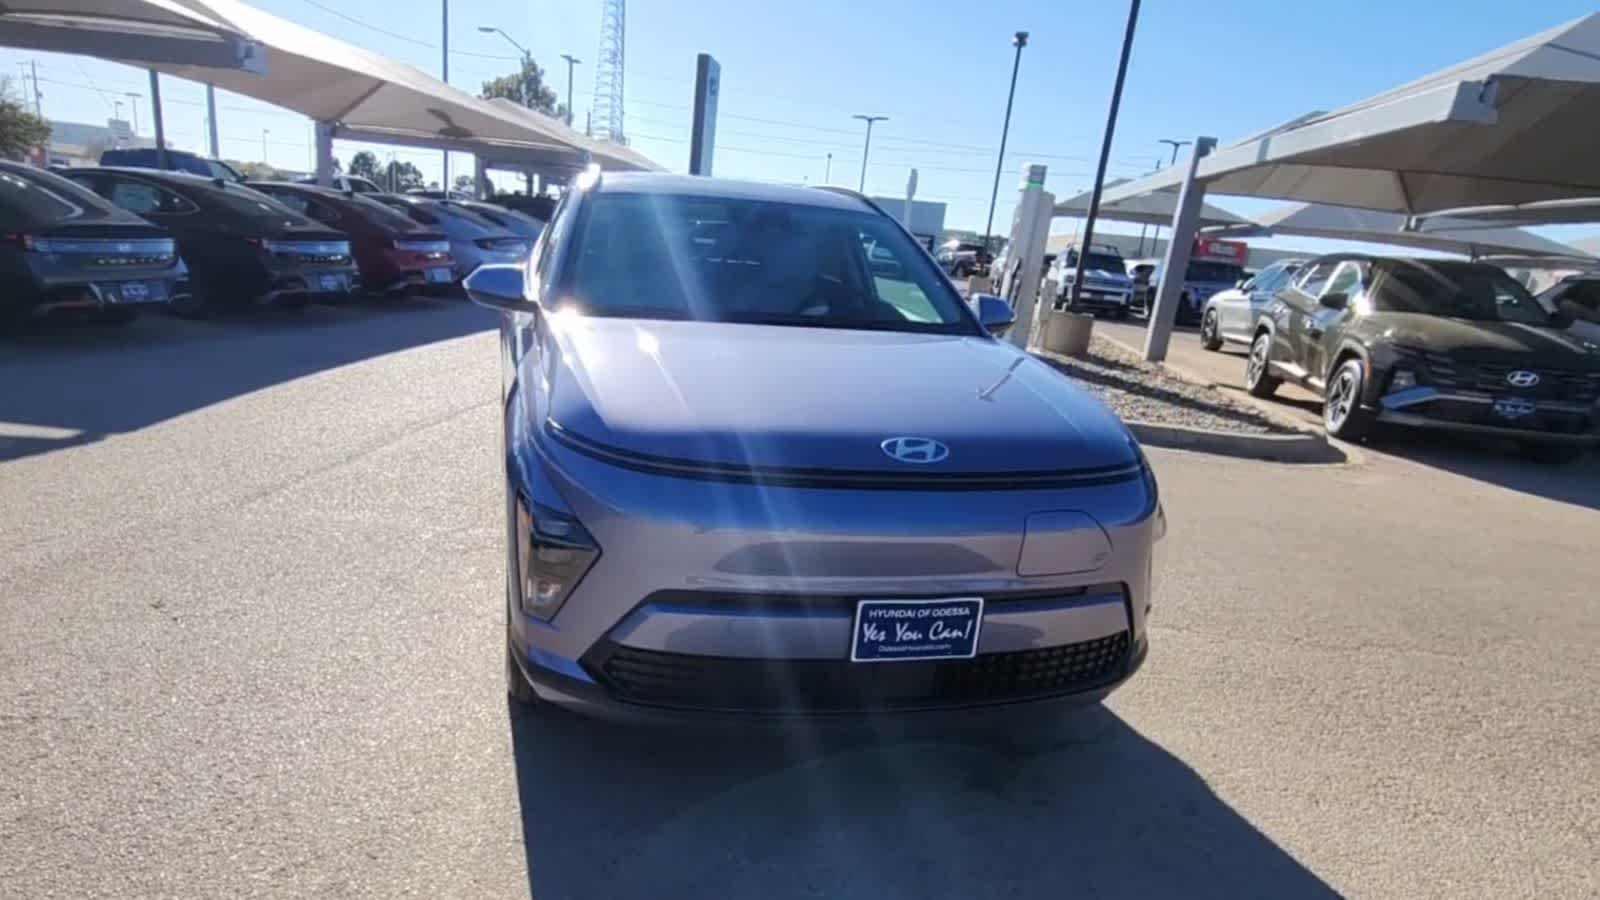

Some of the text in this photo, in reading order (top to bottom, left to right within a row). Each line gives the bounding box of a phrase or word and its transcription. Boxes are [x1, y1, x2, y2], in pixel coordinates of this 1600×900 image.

[868, 607, 971, 619] HYUNDAI OF ODESSA
[863, 619, 973, 643] Yes You Can!
